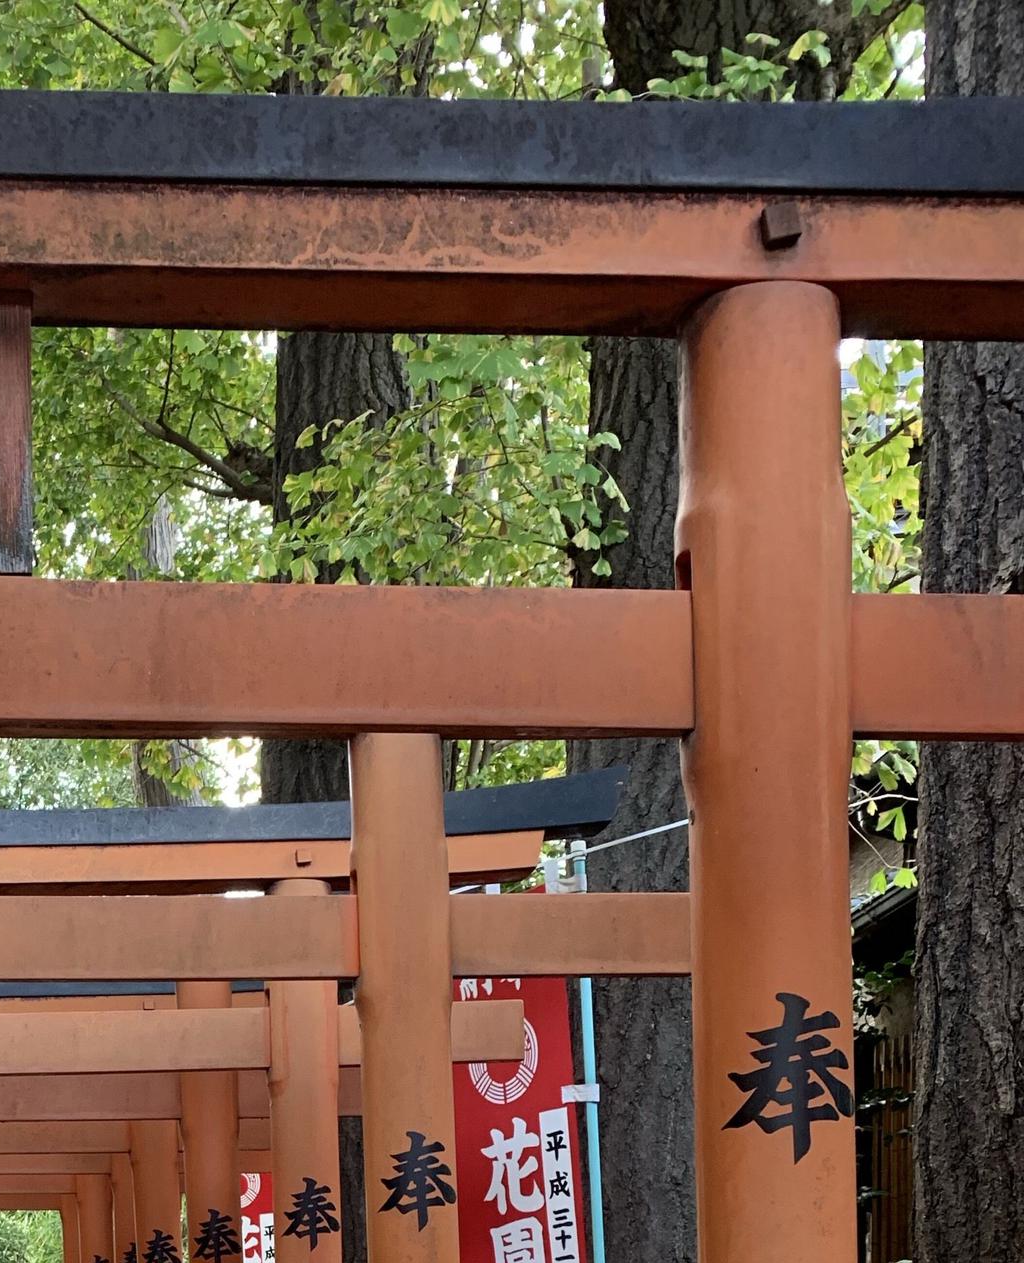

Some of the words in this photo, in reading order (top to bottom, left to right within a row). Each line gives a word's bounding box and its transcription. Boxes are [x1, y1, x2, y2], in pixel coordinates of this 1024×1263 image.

[722, 992, 854, 1164] 奉
[281, 1177, 341, 1251] 奉
[378, 1131, 457, 1231] 奉
